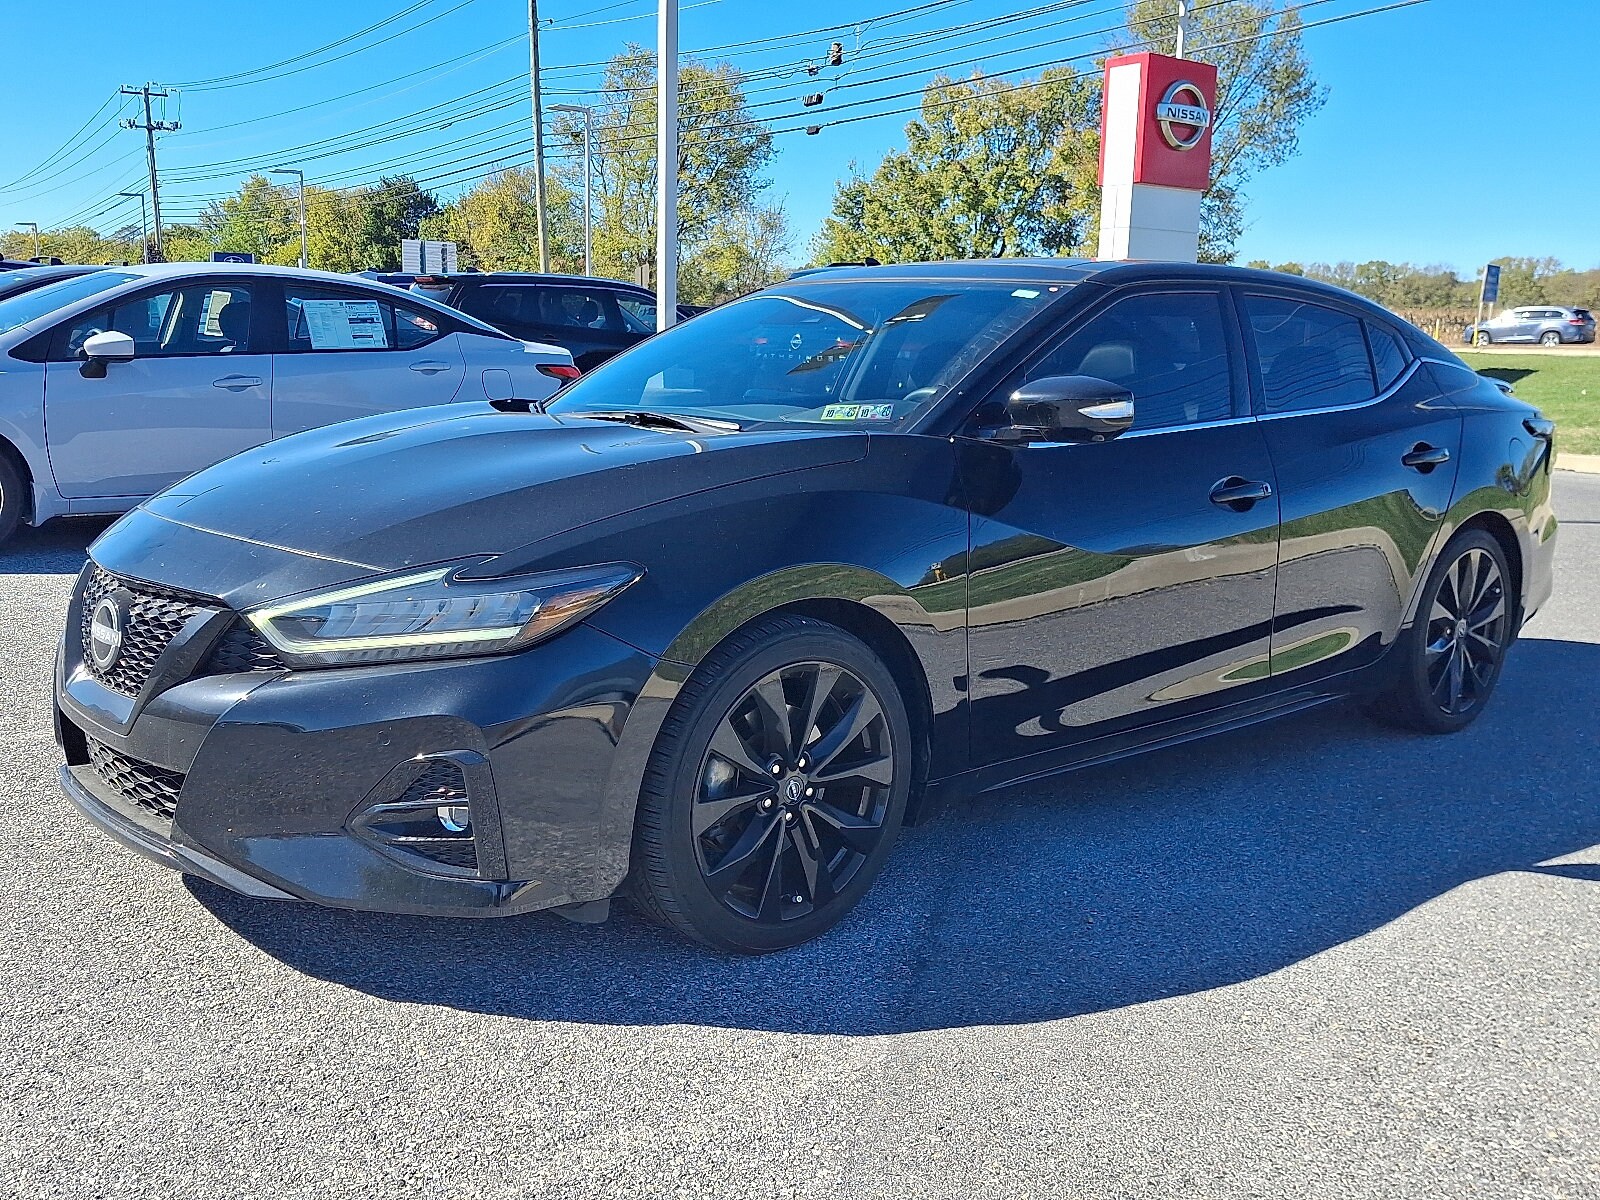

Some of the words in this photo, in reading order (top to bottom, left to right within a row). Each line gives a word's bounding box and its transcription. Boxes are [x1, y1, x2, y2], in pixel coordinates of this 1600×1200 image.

[1167, 107, 1208, 123] NISSAN
[826, 409, 835, 418] 10
[861, 408, 869, 418] 10
[92, 626, 118, 643] NISSAN
